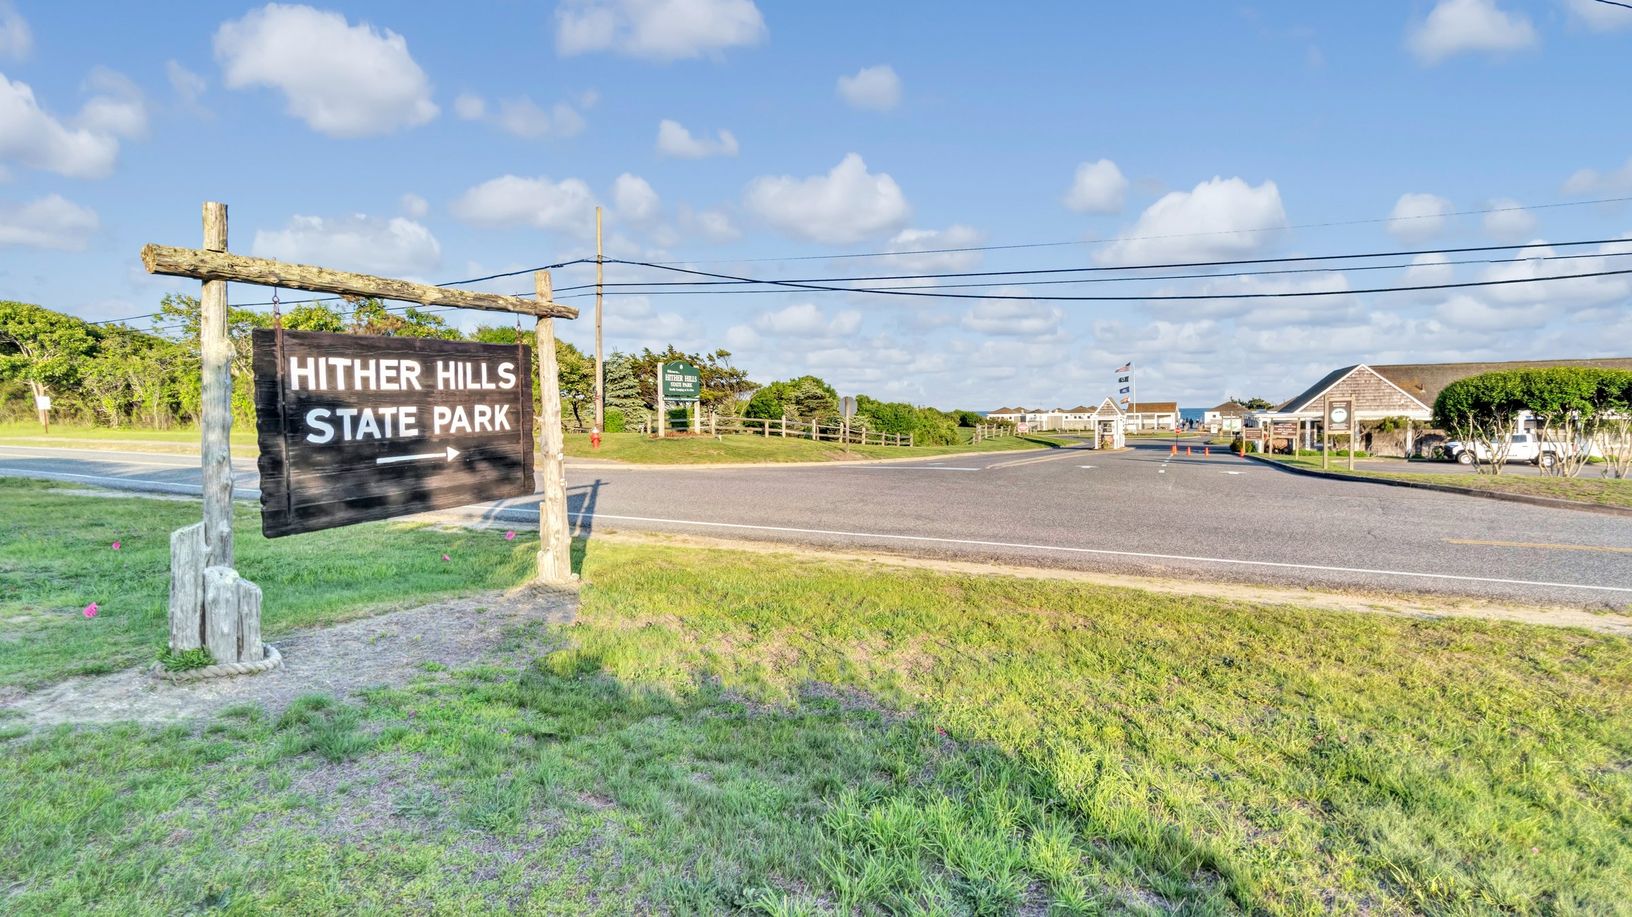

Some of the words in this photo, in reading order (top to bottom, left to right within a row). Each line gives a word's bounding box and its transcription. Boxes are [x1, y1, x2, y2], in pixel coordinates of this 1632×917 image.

[290, 356, 422, 390] HITHER
[437, 360, 516, 390] HILLS
[306, 406, 418, 444] STATE
[434, 404, 511, 435] PARK
